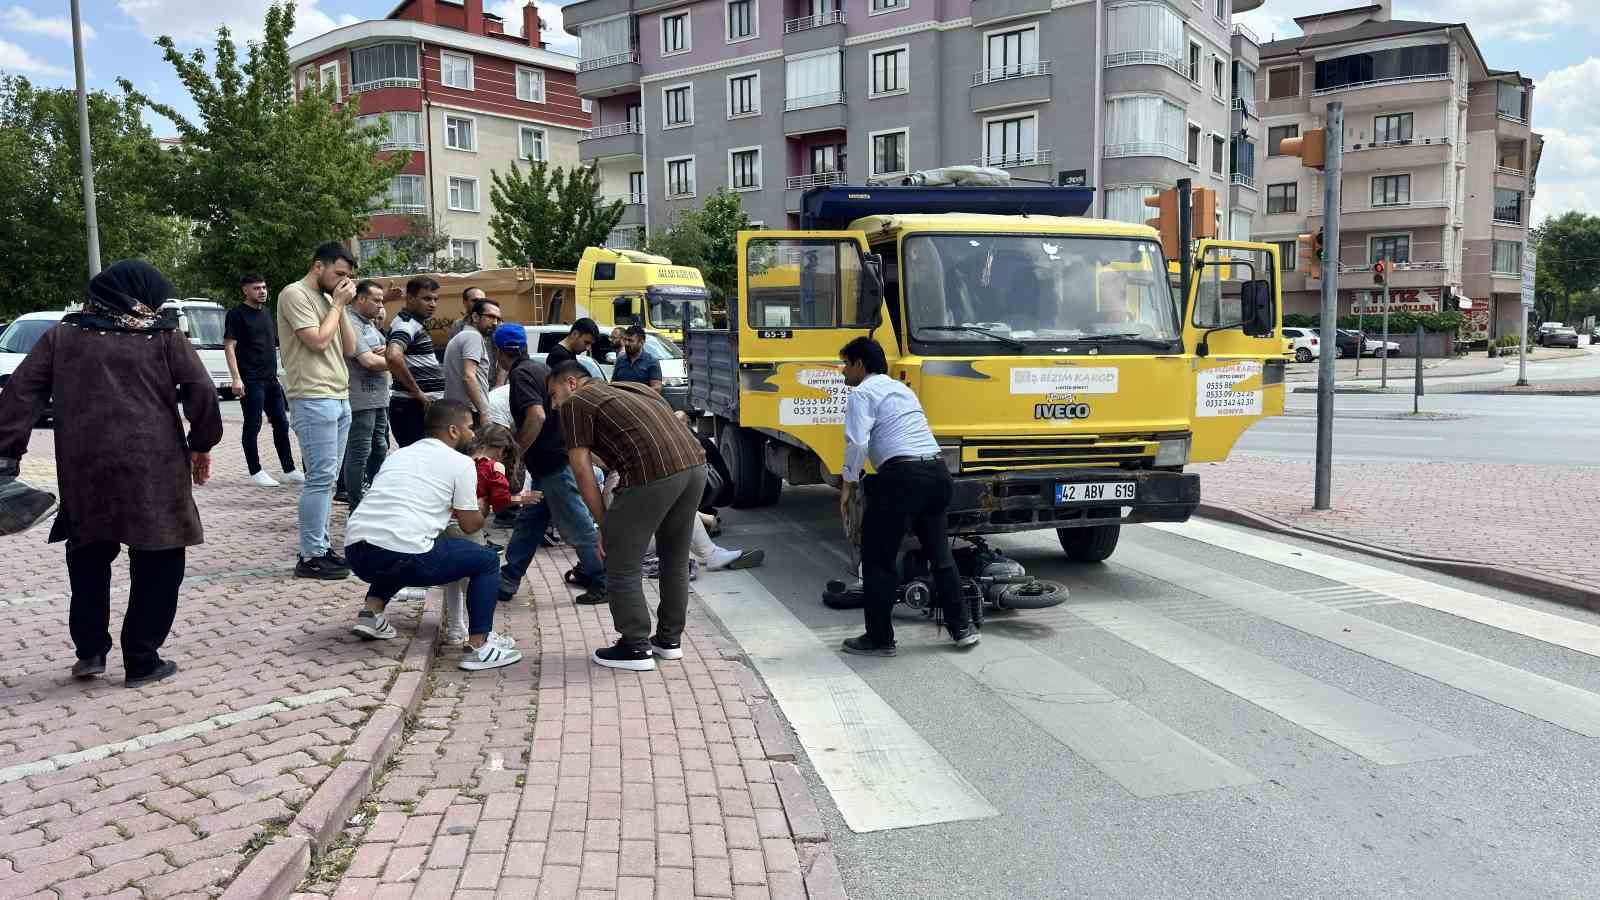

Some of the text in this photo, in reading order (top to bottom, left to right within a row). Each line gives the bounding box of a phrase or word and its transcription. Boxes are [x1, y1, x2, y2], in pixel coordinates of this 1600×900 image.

[1353, 305, 1378, 314] ULU
[820, 406, 839, 414] 342
[1034, 403, 1090, 419] IVECO
[1063, 486, 1076, 500] 42
[1085, 485, 1105, 499] ABV
[1115, 484, 1134, 498] 619
